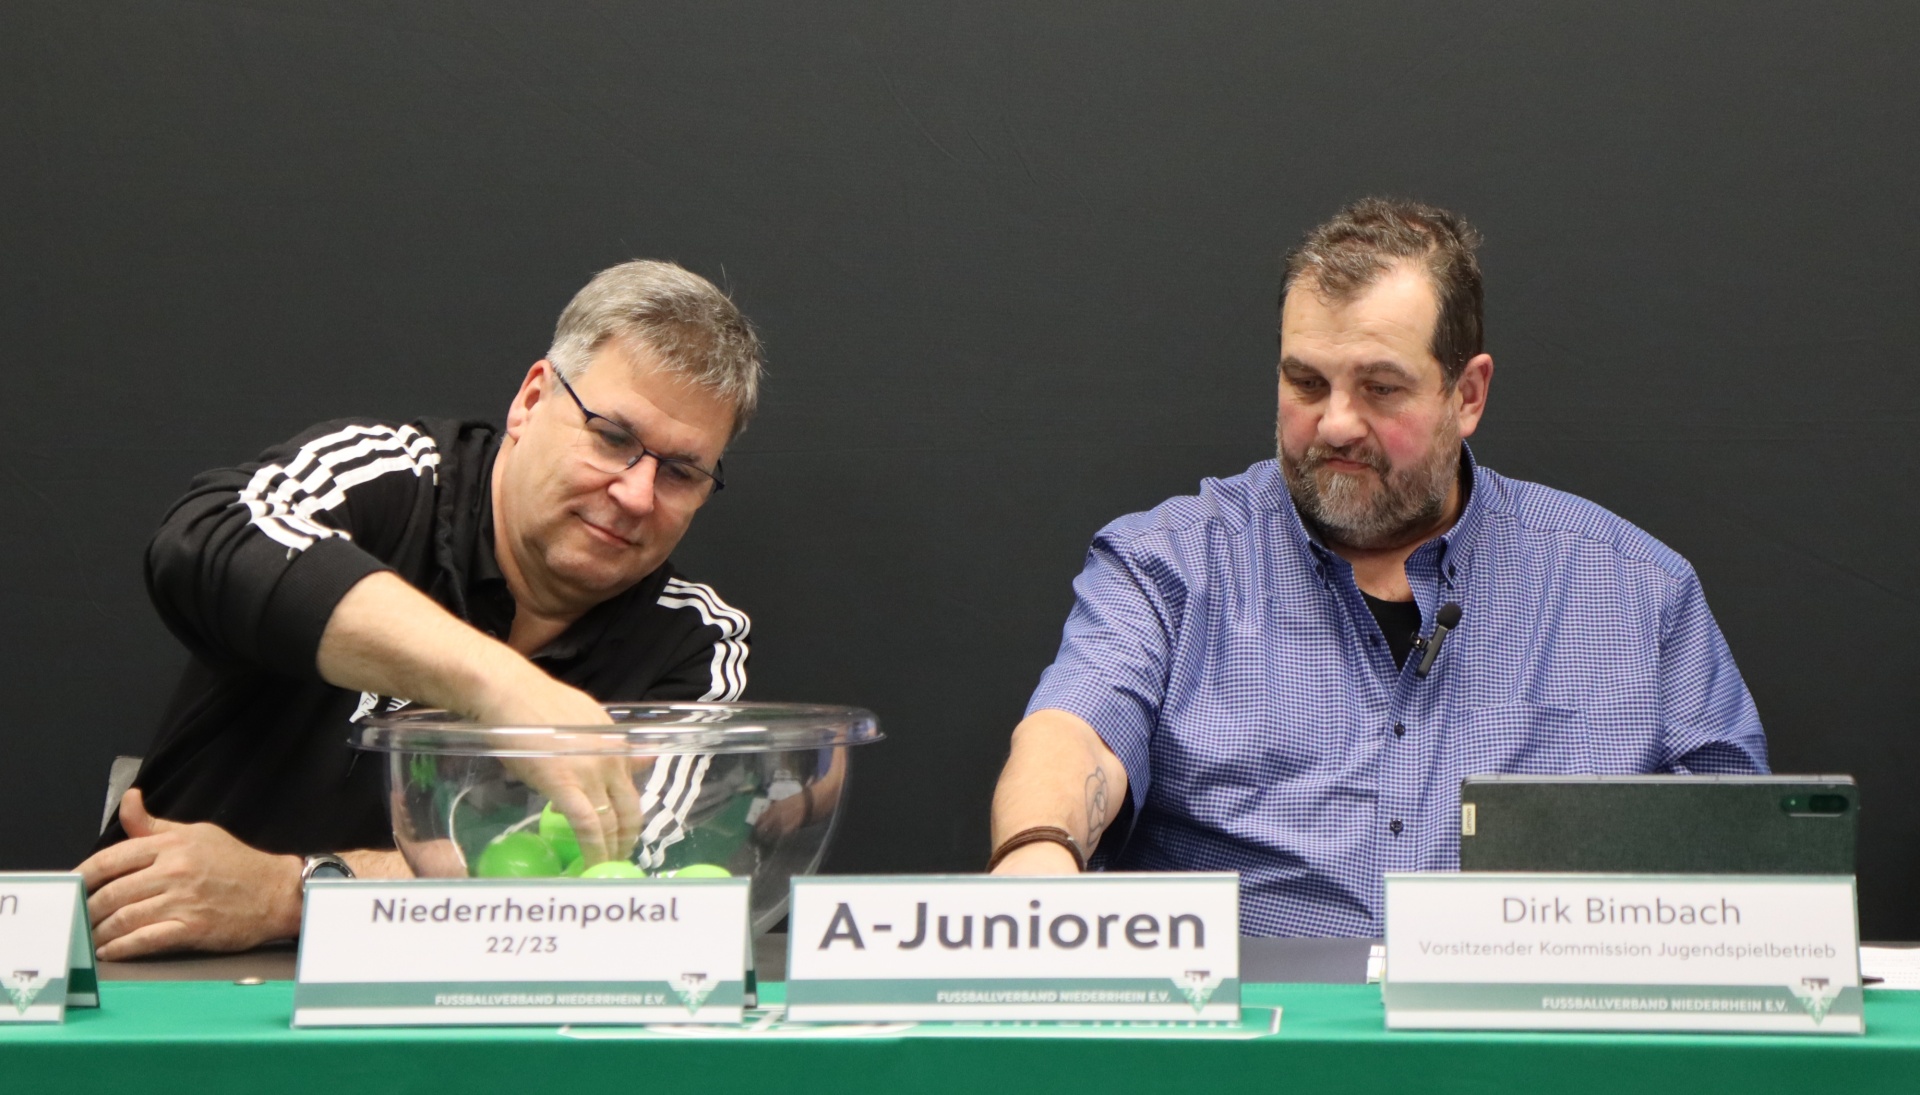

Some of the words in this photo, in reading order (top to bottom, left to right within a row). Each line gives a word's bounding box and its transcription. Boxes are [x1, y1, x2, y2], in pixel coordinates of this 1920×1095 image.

[371, 897, 680, 928] Niederrheinpokal
[1502, 896, 1572, 925] Dirk
[1585, 897, 1741, 926] Bimbach
[818, 899, 1206, 949] A-Junioren
[485, 936, 559, 955] 22/23
[1418, 940, 1534, 957] Vorsitzender
[1539, 941, 1652, 958] Kommission
[1657, 942, 1837, 961] Jugendspielbetrieb
[434, 994, 553, 1006] FUSSBALLVERBAND
[556, 994, 642, 1006] NIEDERRHEIN
[644, 994, 666, 1006] E.V.
[936, 990, 1057, 1003] FUSSBALLVERBAND
[1060, 991, 1146, 1003] NIEDERRHEIN
[1149, 991, 1171, 1003] E.V.
[1542, 996, 1668, 1011] FUSSBALLVERBAND
[1670, 998, 1762, 1013] NIEDERRHEIN
[1764, 999, 1789, 1014] E.V.
